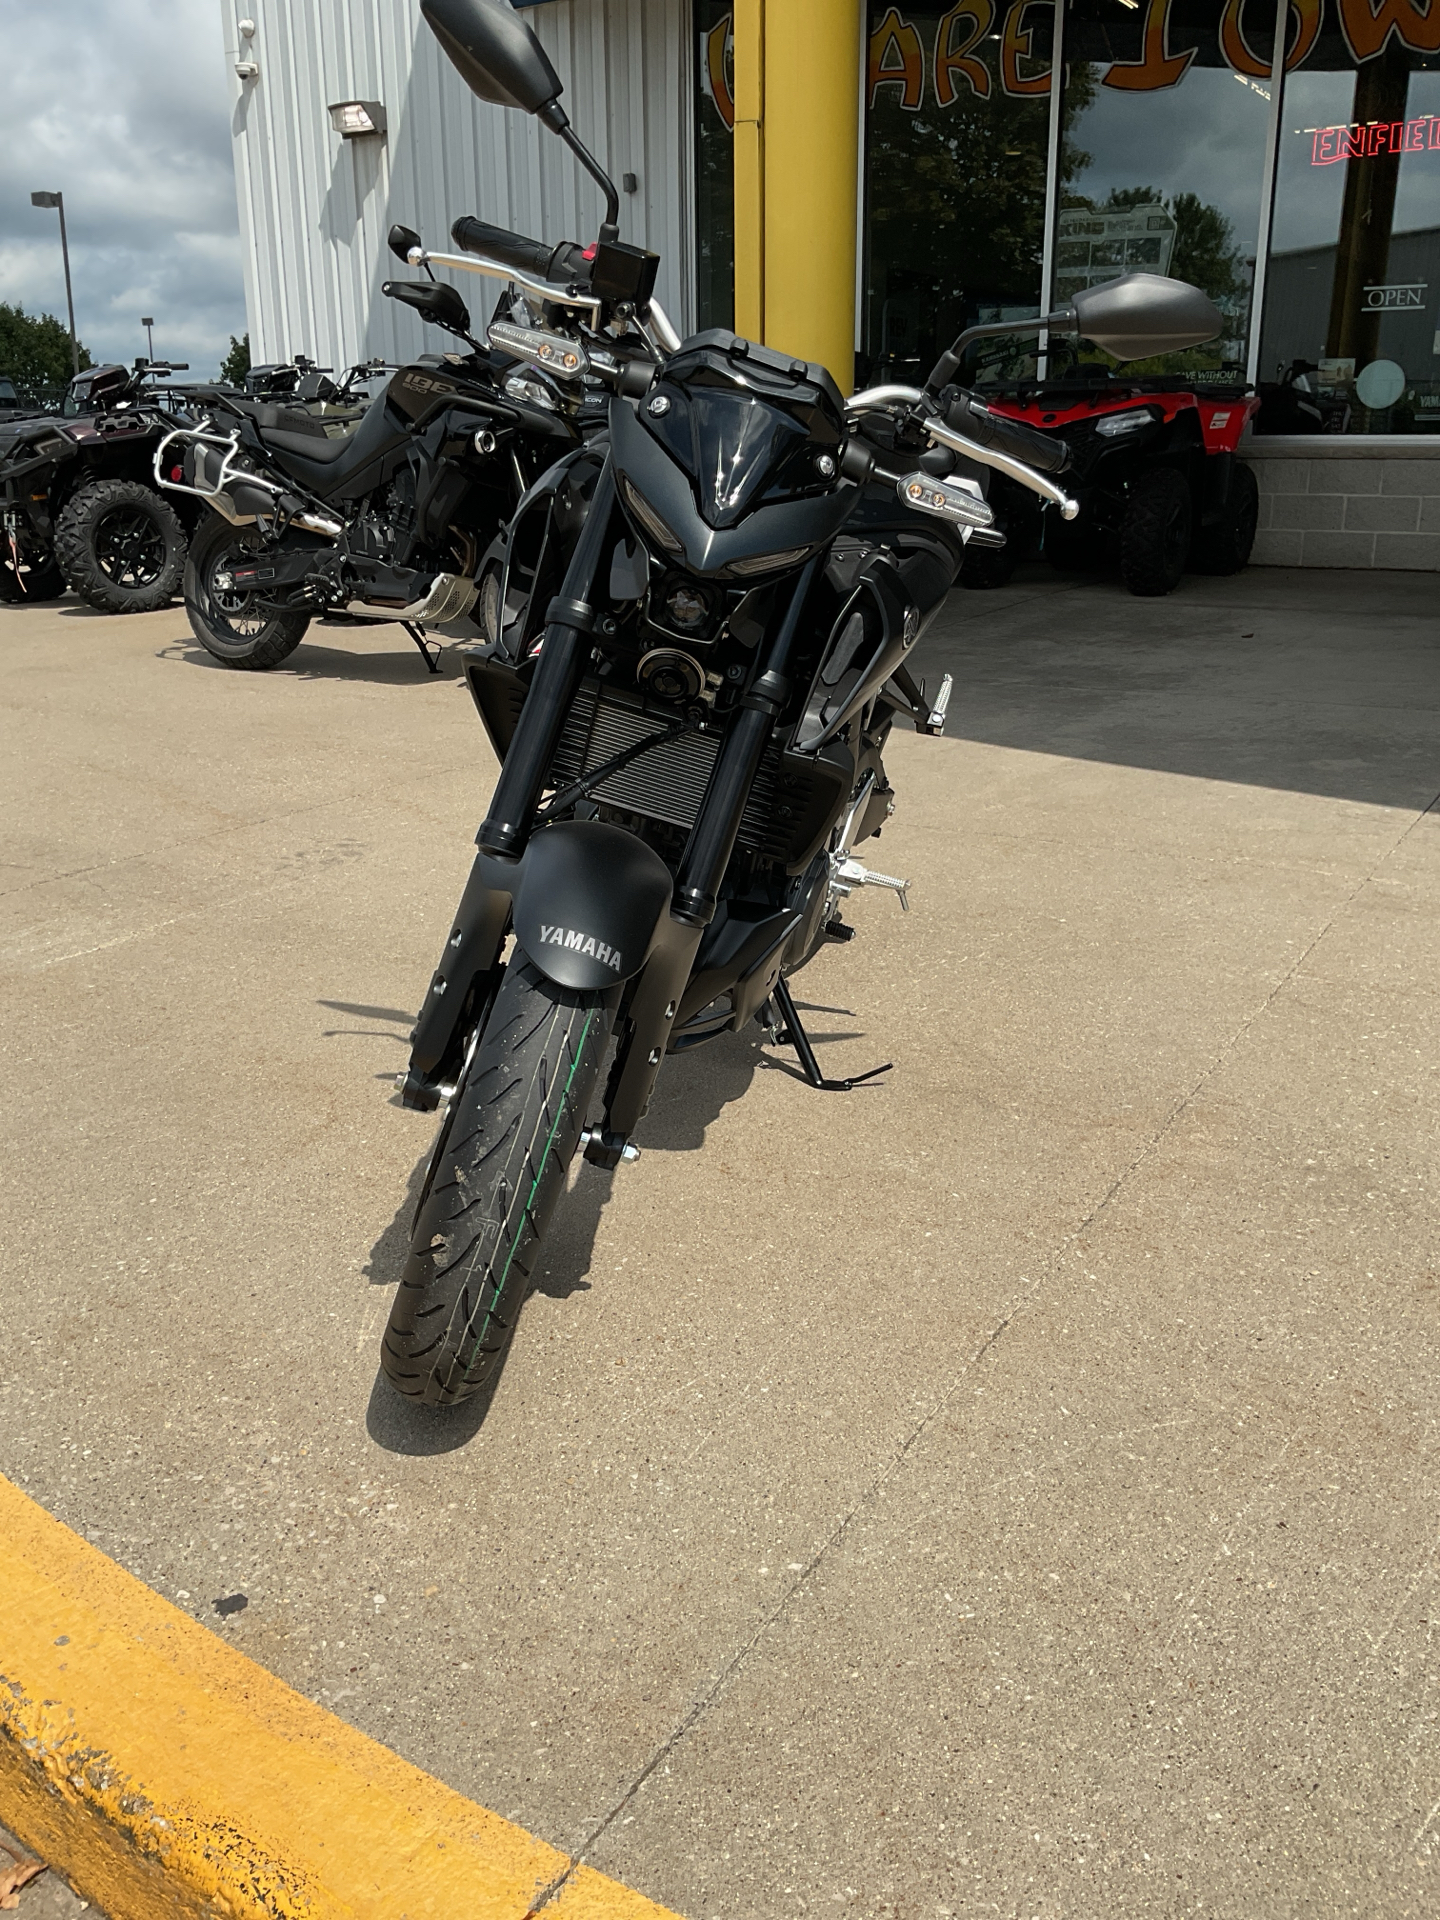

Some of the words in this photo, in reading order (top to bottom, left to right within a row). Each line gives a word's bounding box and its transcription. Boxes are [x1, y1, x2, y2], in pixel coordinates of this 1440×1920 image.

[1367, 288, 1422, 307] OPEN
[1197, 370, 1238, 380] WITHOUT
[540, 925, 621, 971] YAMAHA
